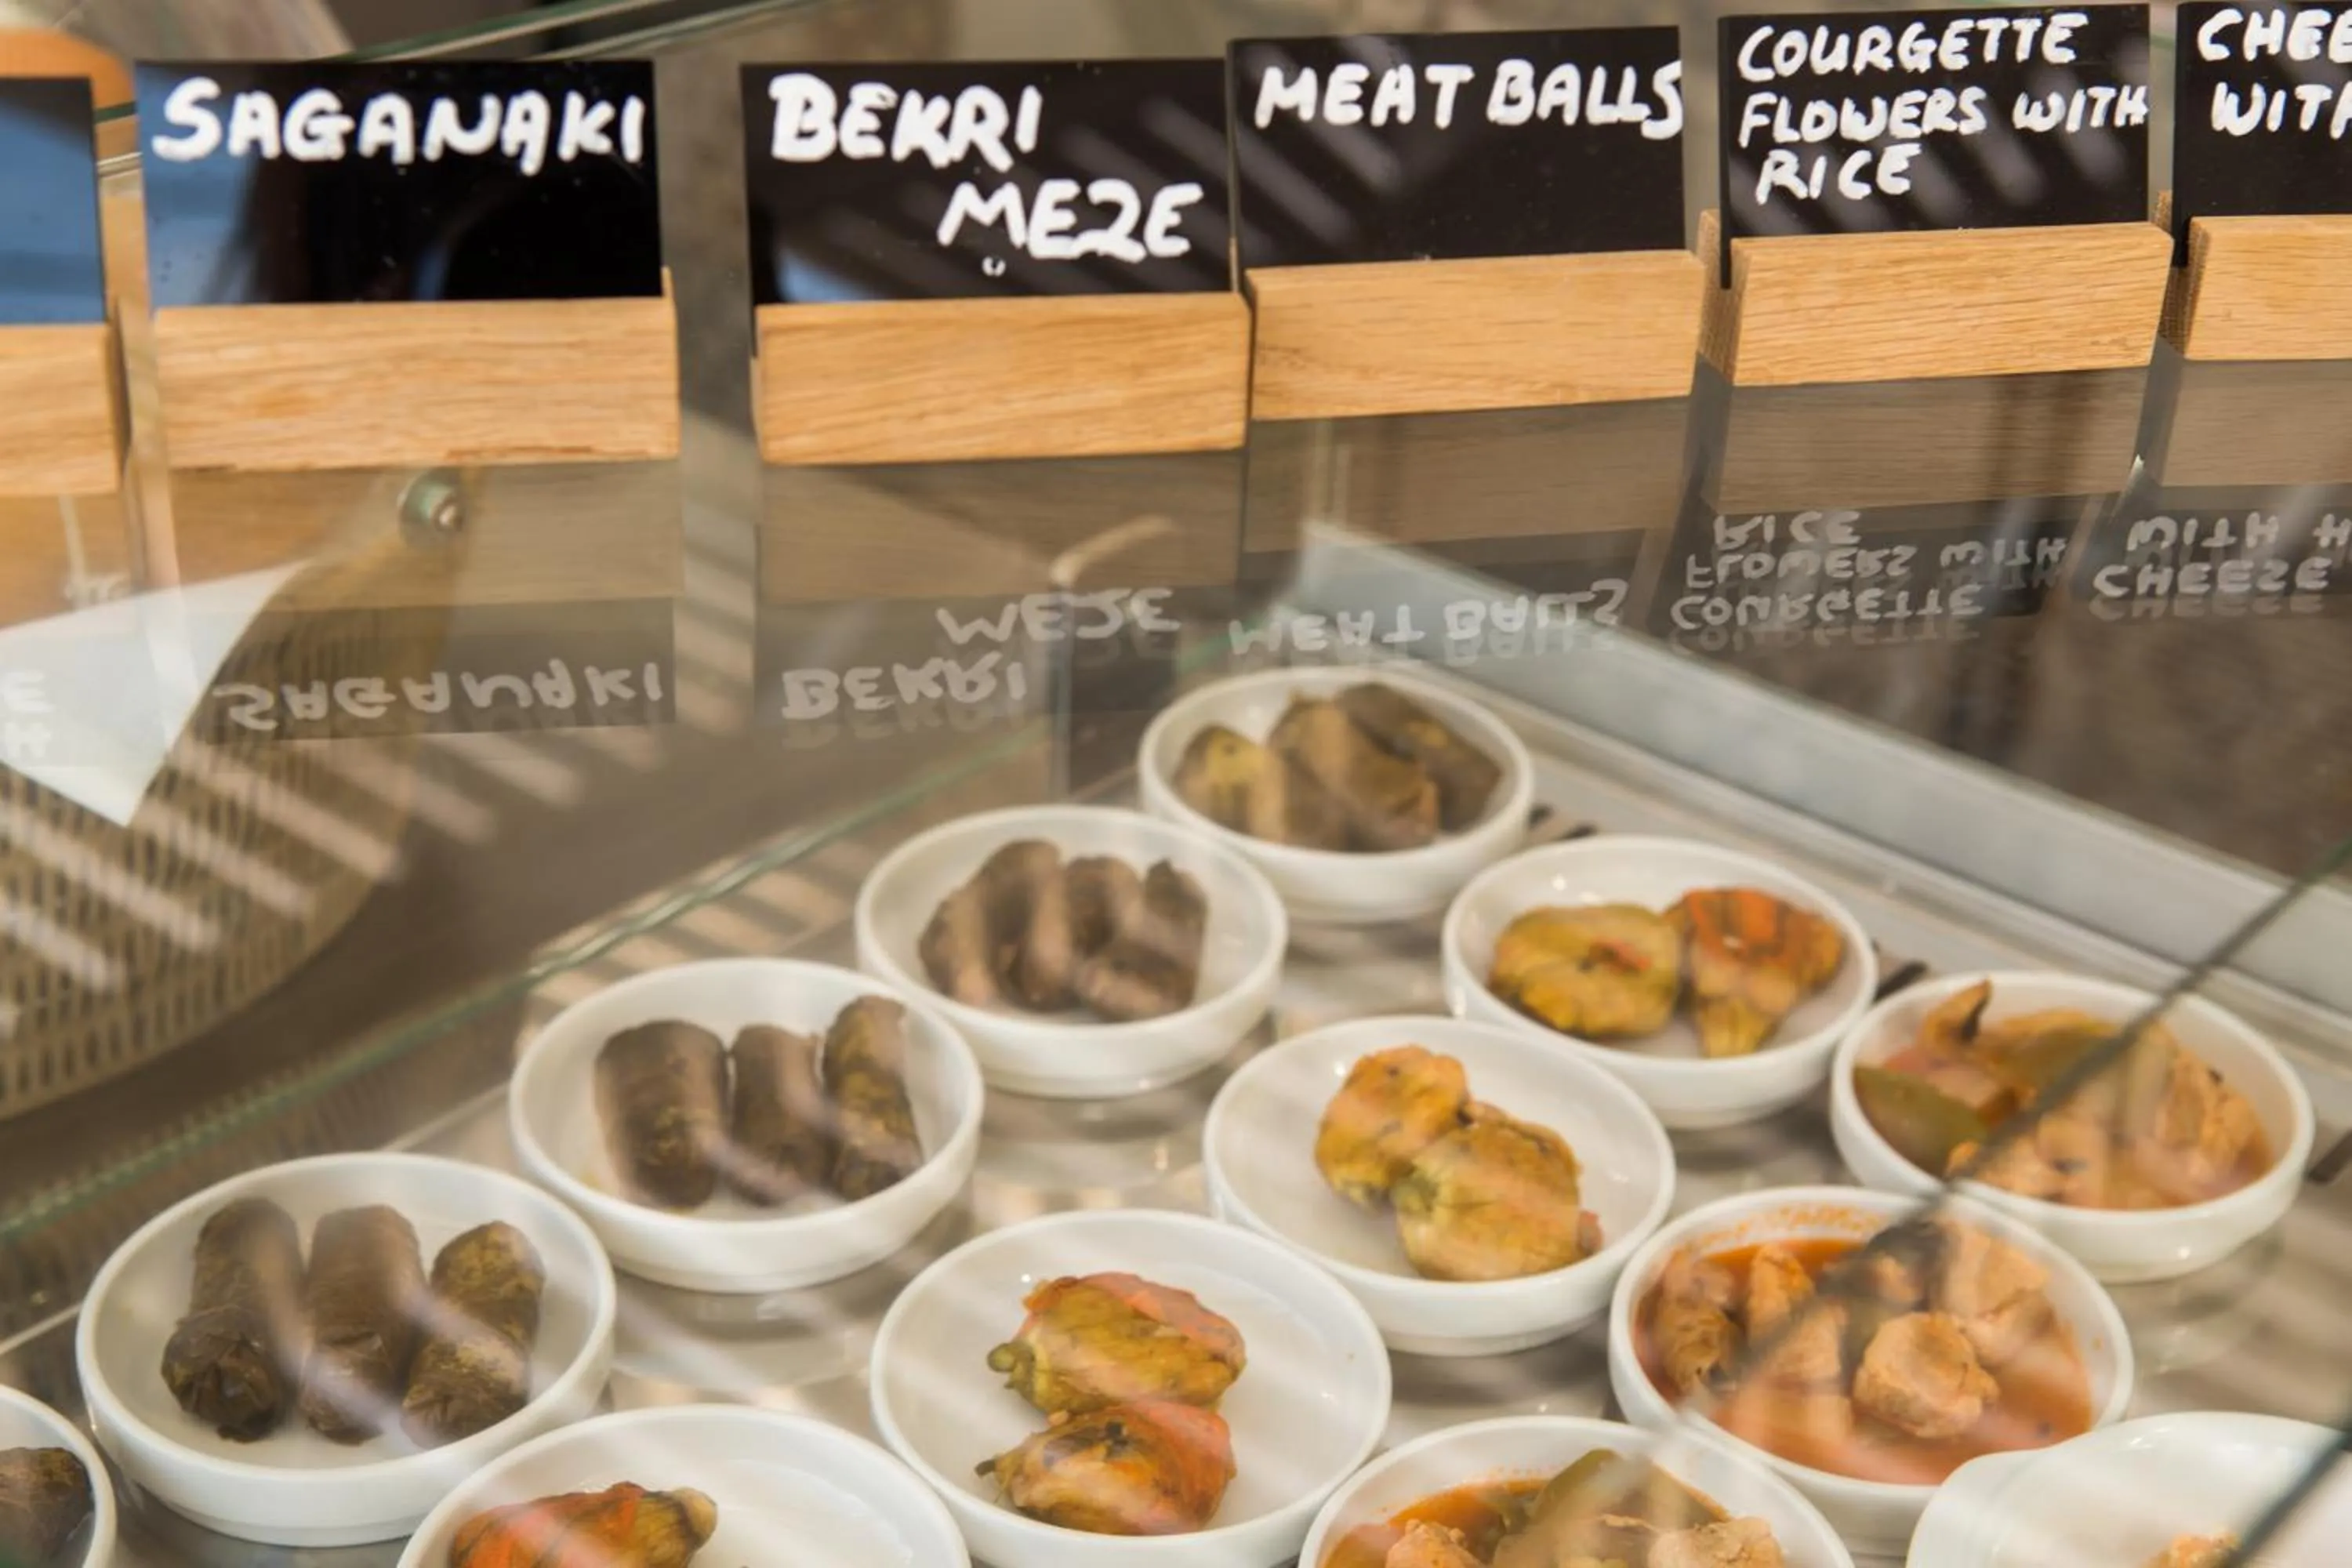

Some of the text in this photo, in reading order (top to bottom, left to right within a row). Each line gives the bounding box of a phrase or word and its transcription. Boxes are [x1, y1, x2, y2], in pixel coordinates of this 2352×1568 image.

[1737, 13, 2089, 82] COURGETTE
[152, 78, 644, 175] SAGANAKI
[768, 73, 1042, 172] BEKRI
[1254, 59, 1682, 140] MEAT BALLS
[1739, 85, 2149, 148] FLOWERS WITH
[1755, 142, 1922, 205] RICE
